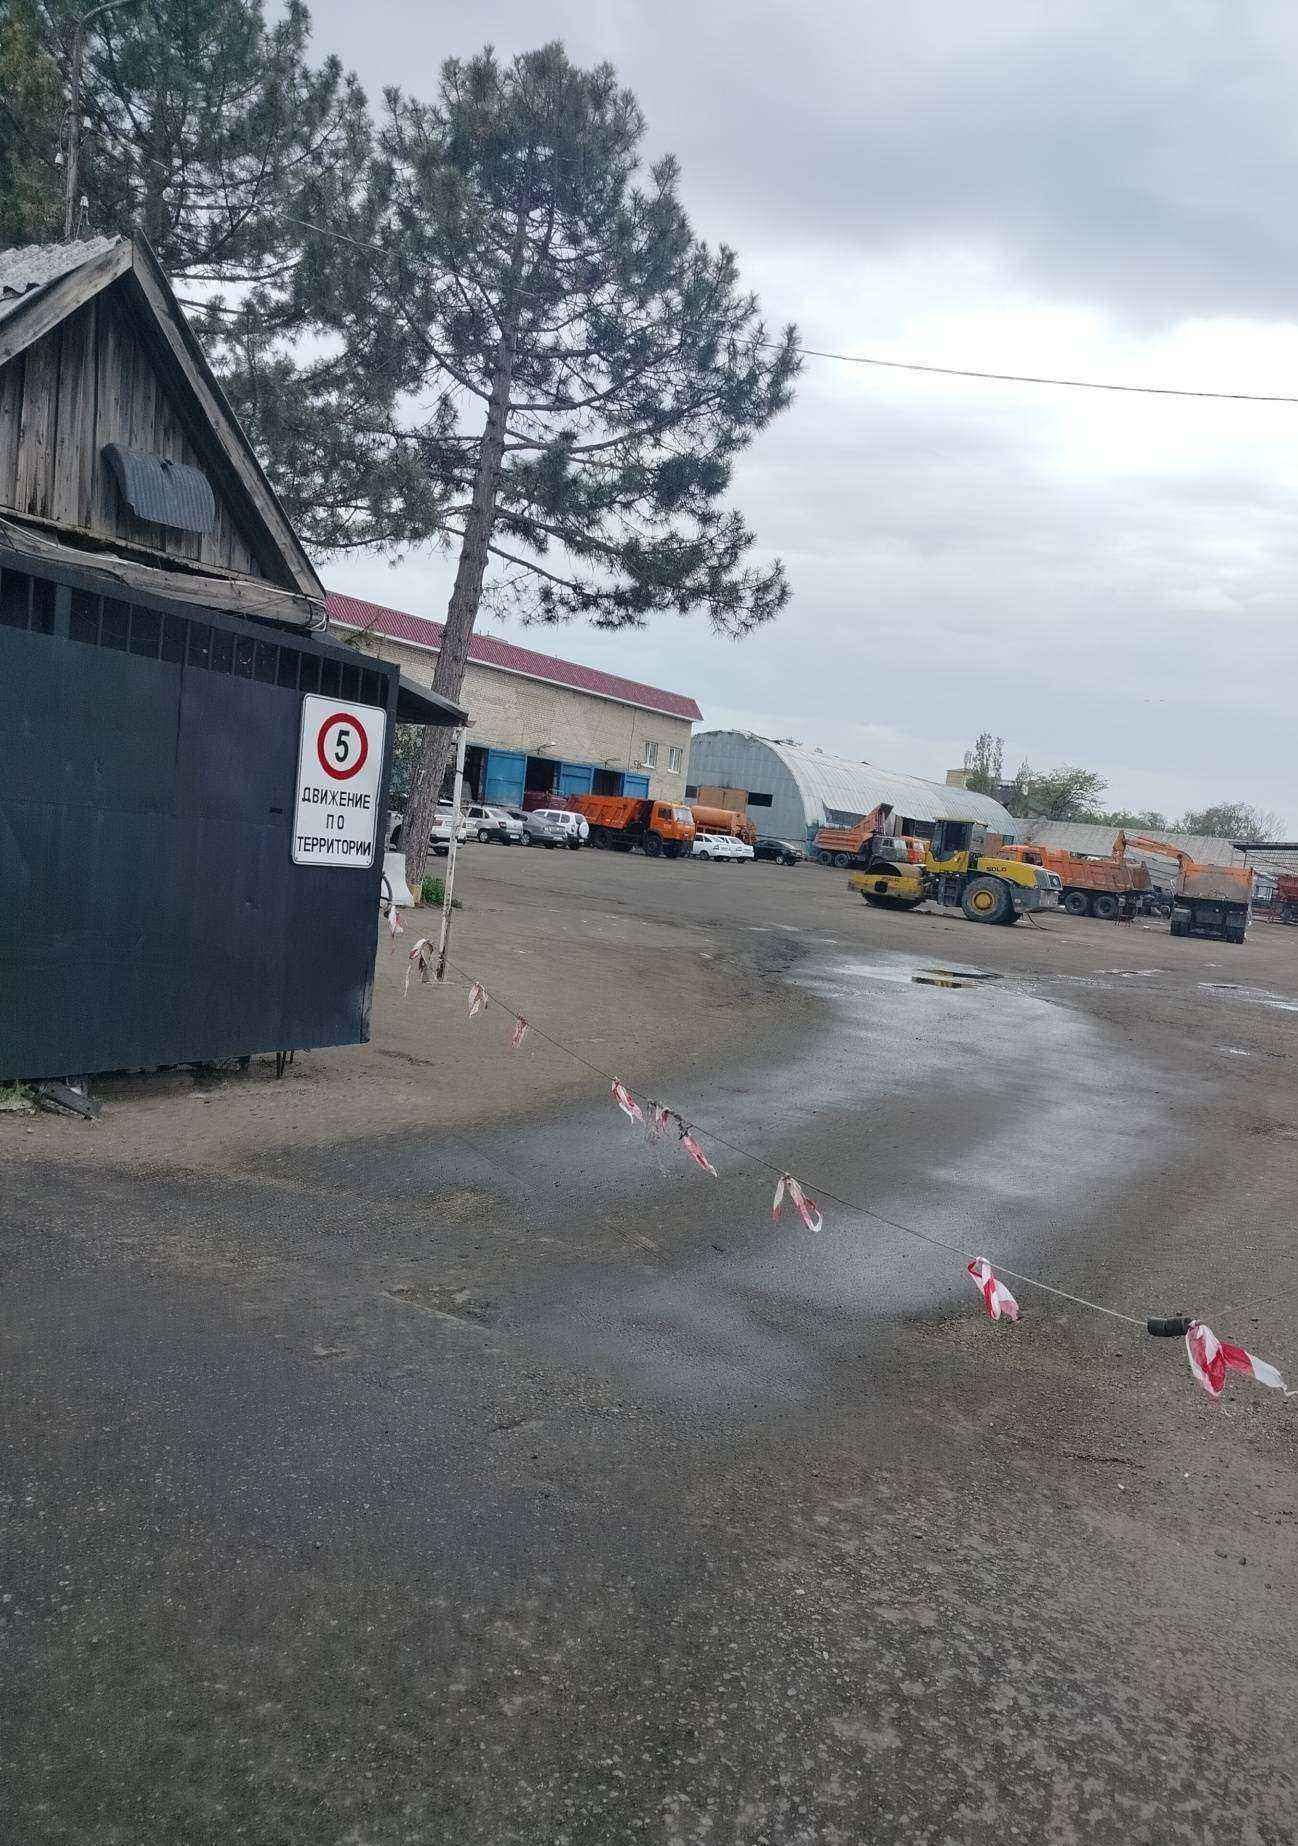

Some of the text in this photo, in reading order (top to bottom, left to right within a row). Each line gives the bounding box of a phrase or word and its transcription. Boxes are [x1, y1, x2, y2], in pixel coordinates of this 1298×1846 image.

[334, 729, 350, 763] 5
[302, 787, 371, 809] ДВИЖЕНИЕ
[326, 814, 345, 830] ПО
[297, 836, 372, 856] ТЕРРИТОРИИ
